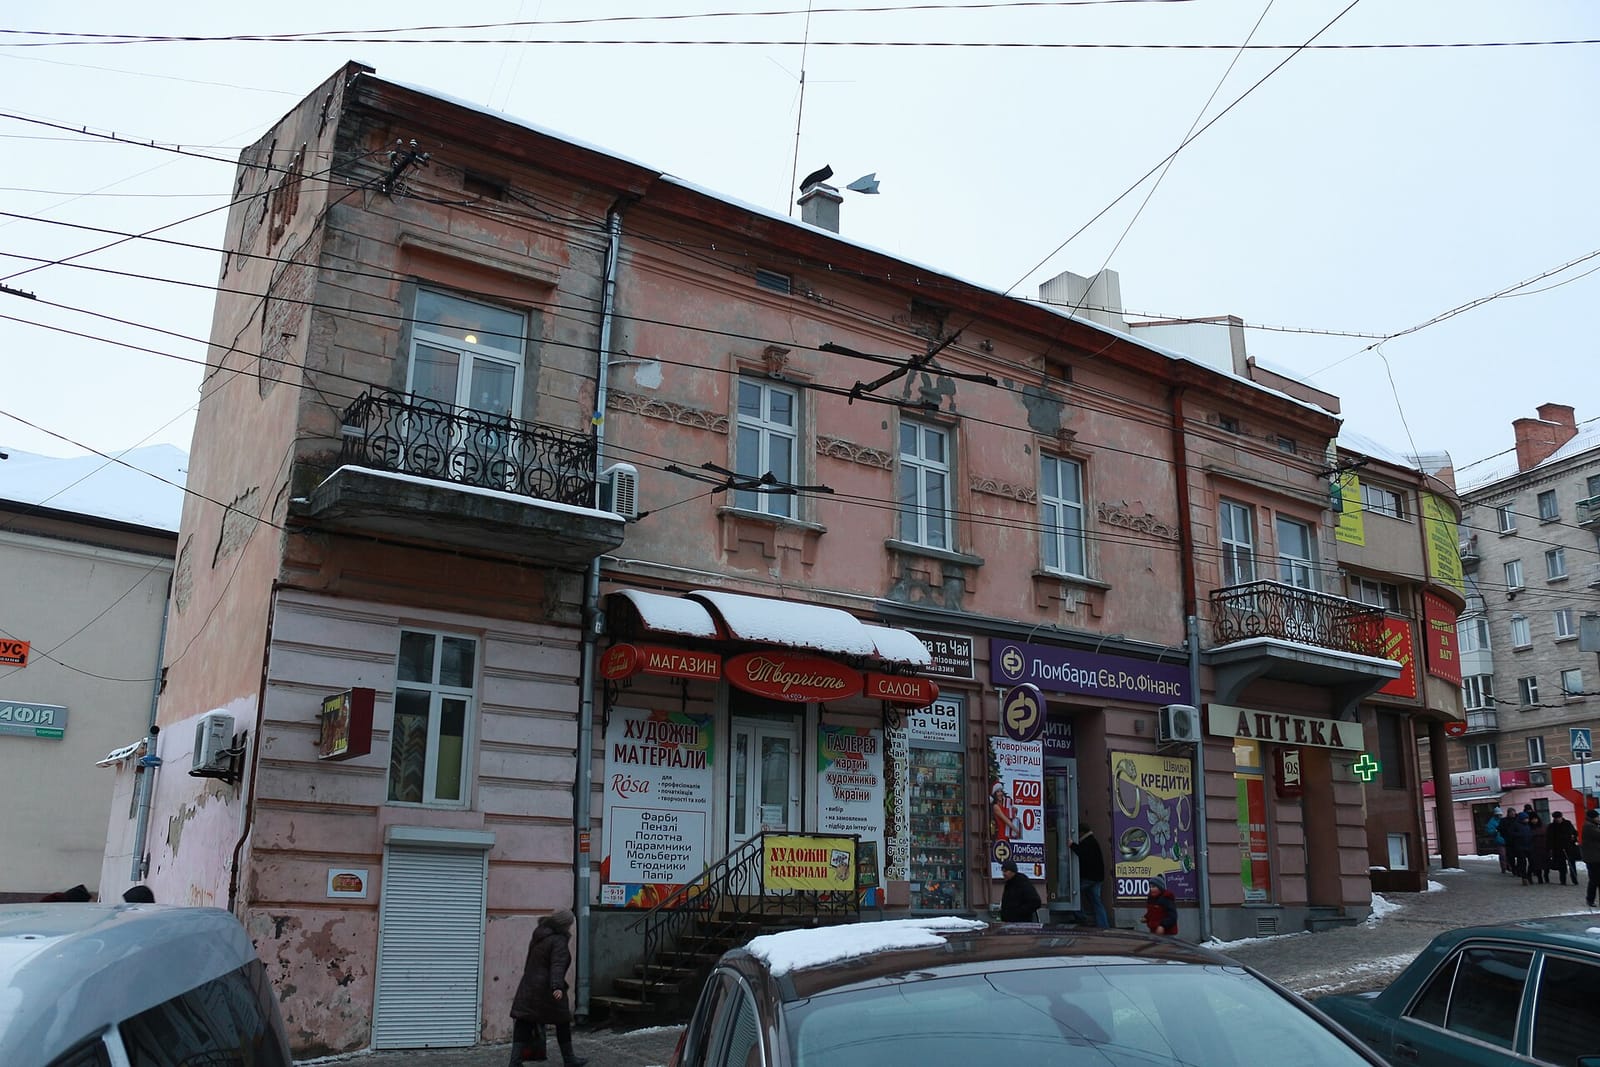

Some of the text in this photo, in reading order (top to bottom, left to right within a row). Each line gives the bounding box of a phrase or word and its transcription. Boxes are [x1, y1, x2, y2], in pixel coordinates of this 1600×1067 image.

[0, 643, 23, 655] УС
[936, 641, 947, 654] та
[949, 640, 969, 657] Чай
[649, 653, 716, 674] МАГАЗИН
[746, 656, 846, 693] Творчість
[1031, 659, 1181, 697] Ломбард Єв.Ро.Фінанс
[878, 680, 920, 697] САЛОН
[911, 717, 956, 731] та Чай
[1236, 710, 1344, 748] АПТЕКА
[624, 719, 698, 744] ХУДОЖНІ
[827, 734, 876, 754] ГАЛЕРЕЯ
[996, 741, 1041, 753] Новорічний
[614, 743, 706, 770] МАТЕРІАЛИ
[835, 759, 868, 772] картин
[827, 773, 878, 786] художників
[1141, 773, 1190, 792] КРЕДИТИ
[833, 785, 870, 802] України
[1015, 781, 1039, 798] 700
[641, 812, 678, 823] Фарби
[641, 822, 678, 832] Пензлі
[635, 831, 683, 842] Полотна
[625, 840, 692, 851] Підрамники
[1013, 844, 1043, 855] Ломбард
[626, 850, 690, 862] Мольберти
[770, 847, 828, 863] ХУДОЖНІ
[630, 860, 686, 871] Етюдники
[770, 865, 828, 878] МАТЕРІАЛИ
[1116, 865, 1152, 877] під заставу
[642, 870, 674, 881] Папір
